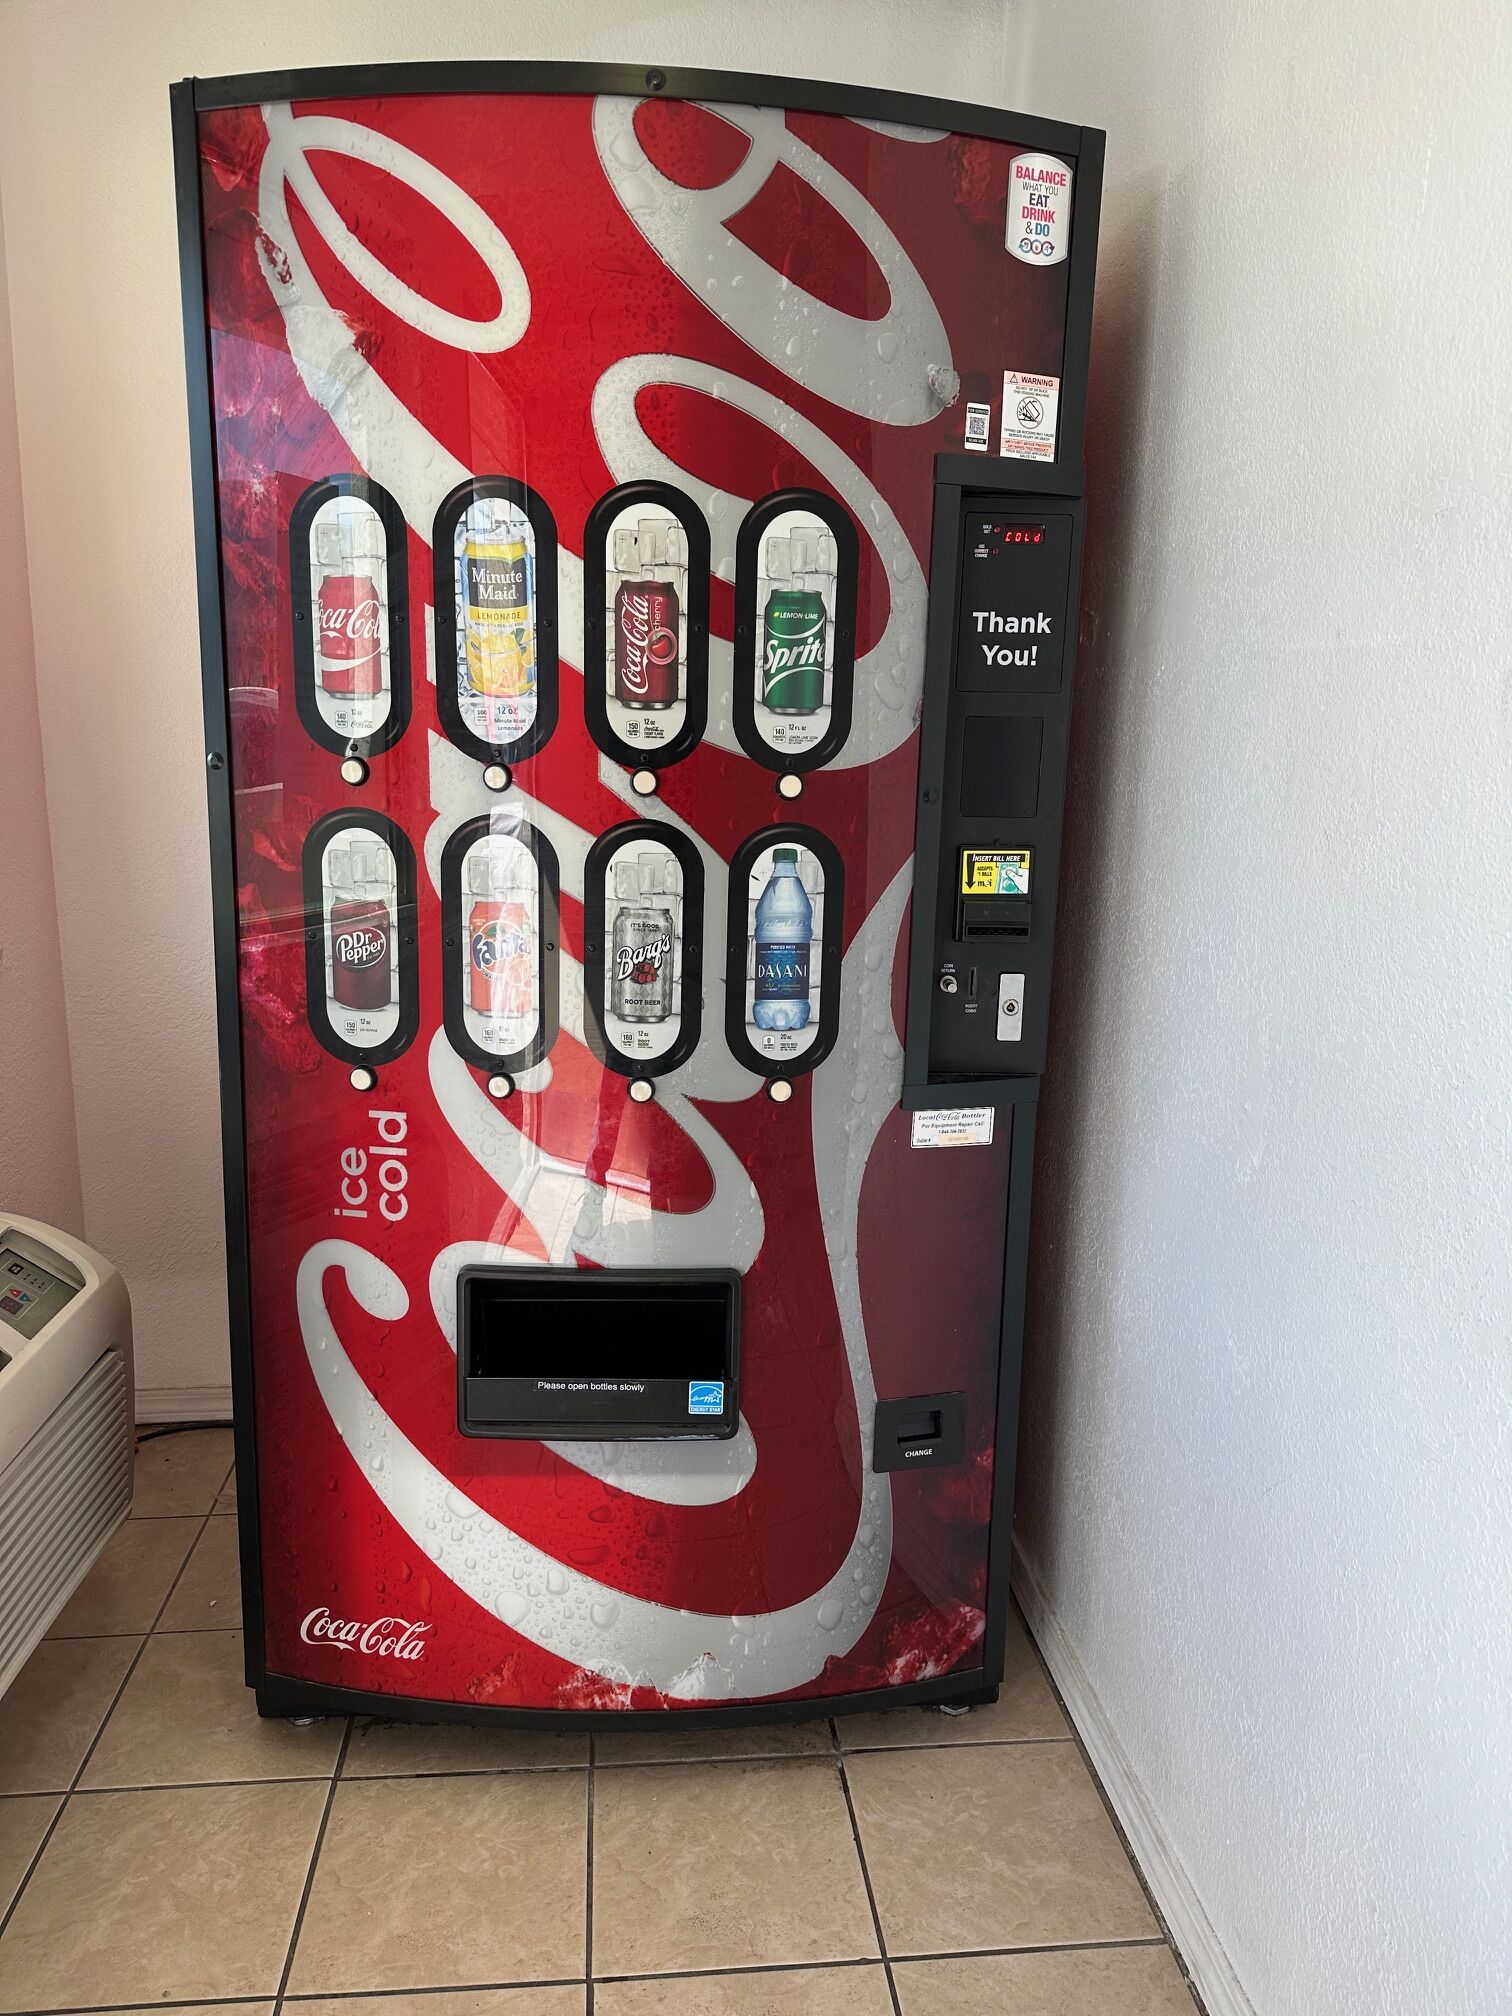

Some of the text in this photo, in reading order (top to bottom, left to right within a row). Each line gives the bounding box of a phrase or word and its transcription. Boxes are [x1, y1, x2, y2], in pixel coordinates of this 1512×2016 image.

[1015, 165, 1067, 187] BALANCE
[1022, 182, 1059, 196] WHAT YOU
[1022, 206, 1056, 224] DRINK
[1025, 221, 1050, 237] & DO
[1021, 376, 1054, 387] WARNING
[471, 567, 523, 584] Minute
[478, 584, 518, 600] Maid
[477, 611, 522, 621] LEMONADE
[653, 596, 664, 631] cherry
[780, 612, 819, 620] LEMON-LIME
[973, 611, 1052, 634] Thank
[621, 590, 649, 694] Coca-Cola
[764, 636, 825, 674] Sprite
[982, 645, 1038, 666] You!
[498, 706, 506, 714] 12
[972, 854, 992, 862] INSERT
[336, 934, 384, 964] Pepper
[352, 931, 372, 949] Dr
[616, 933, 671, 981] Barq's
[758, 960, 807, 980] DASANI
[368, 1110, 409, 1222] cold
[334, 1147, 368, 1218] ice
[538, 1382, 645, 1392] Please open bottles slowly
[905, 1449, 933, 1458] CHANGE
[300, 1607, 433, 1661] Coca-Cola
